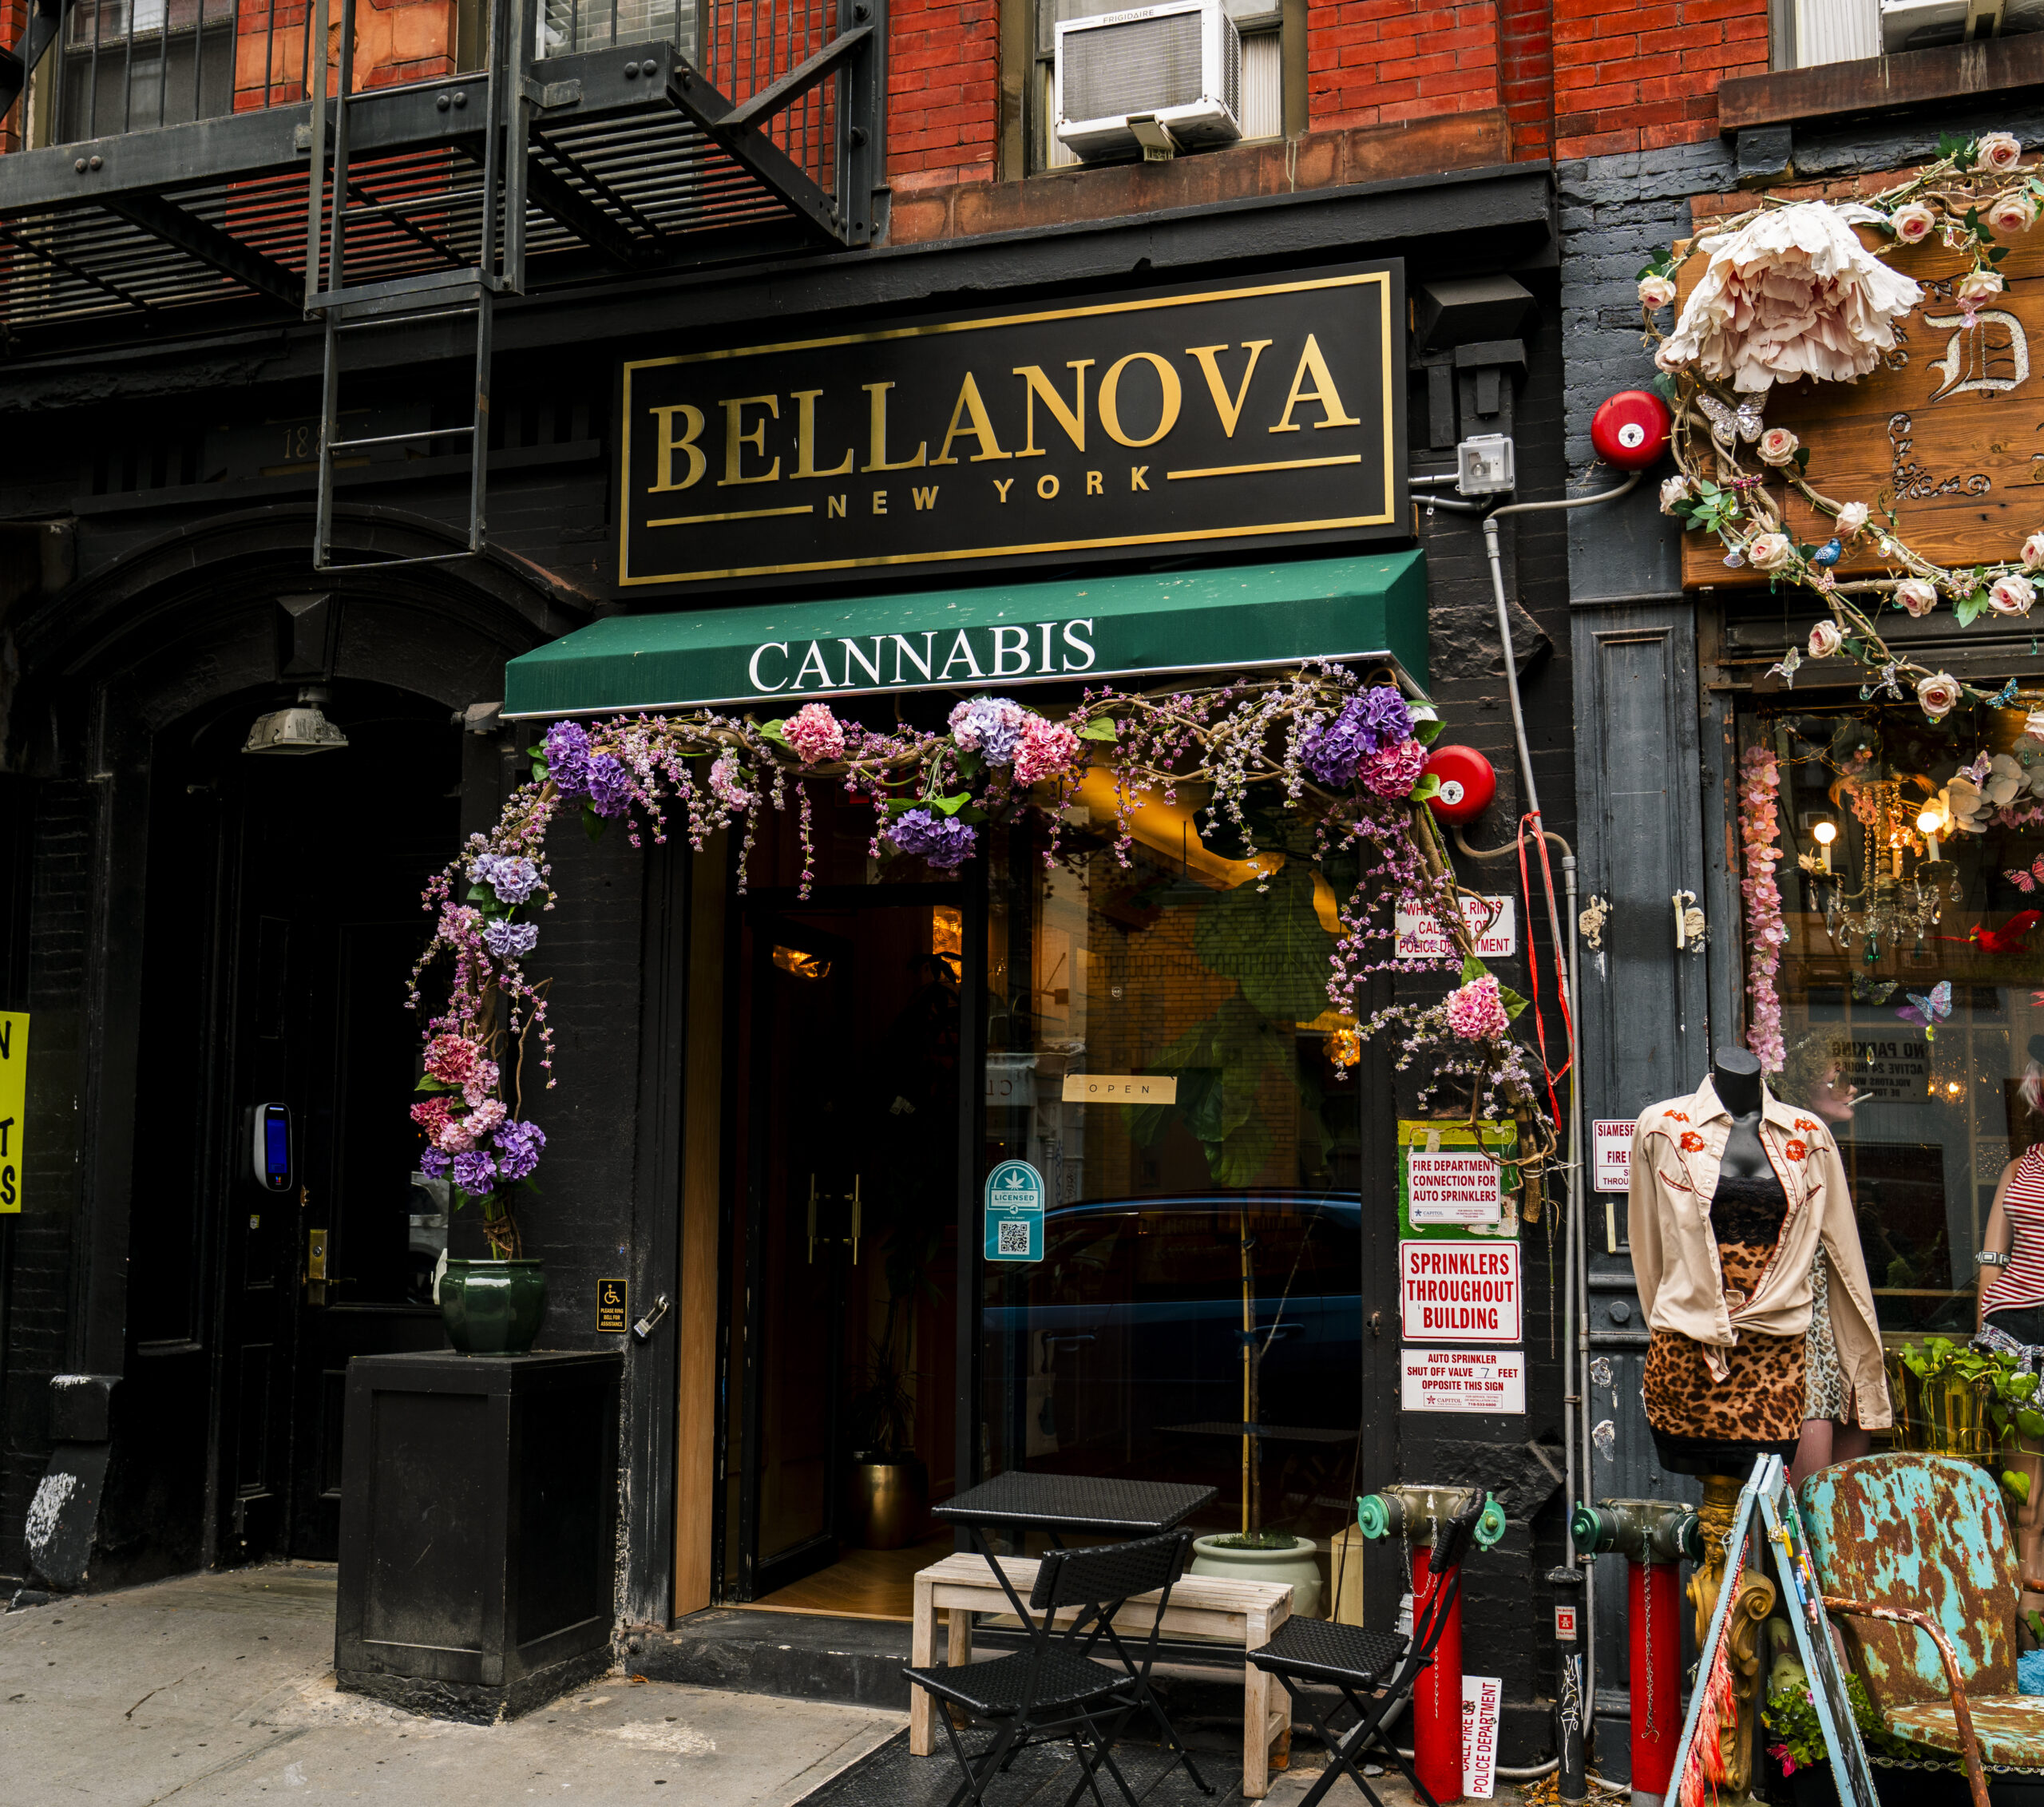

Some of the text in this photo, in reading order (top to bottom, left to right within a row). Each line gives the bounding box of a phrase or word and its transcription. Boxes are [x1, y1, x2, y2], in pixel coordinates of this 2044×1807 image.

[1103, 9, 1155, 24] FRIGIDAIRE
[648, 333, 1361, 493] BELLANOVA
[283, 423, 343, 458] 18
[827, 466, 1150, 519] NEW YORK
[748, 618, 1096, 692] CANNABIS
[1440, 938, 1510, 953] DTMENT
[1088, 1084, 1150, 1094] OPEN
[1607, 1151, 1627, 1163] FIRE
[1412, 1160, 1495, 1171] FIRE DEPARTMENT
[1412, 1175, 1496, 1187] CONNECTION FOR
[1412, 1190, 1496, 1202] AUTO SPRINKLERS
[1410, 1252, 1509, 1275] SPRINKLERS
[1406, 1279, 1514, 1302] THROUGHOUT
[1423, 1306, 1499, 1329] BUILDING
[1428, 1353, 1497, 1364] AUTO SPRINKLER
[1407, 1366, 1519, 1379] SHUT OFF VALVE 7 FEET
[1422, 1380, 1504, 1391] OPPOSITE THIS SIGN
[1462, 1719, 1474, 1742] FIRE
[1473, 1682, 1497, 1793] POLICE DEPARTMENT
